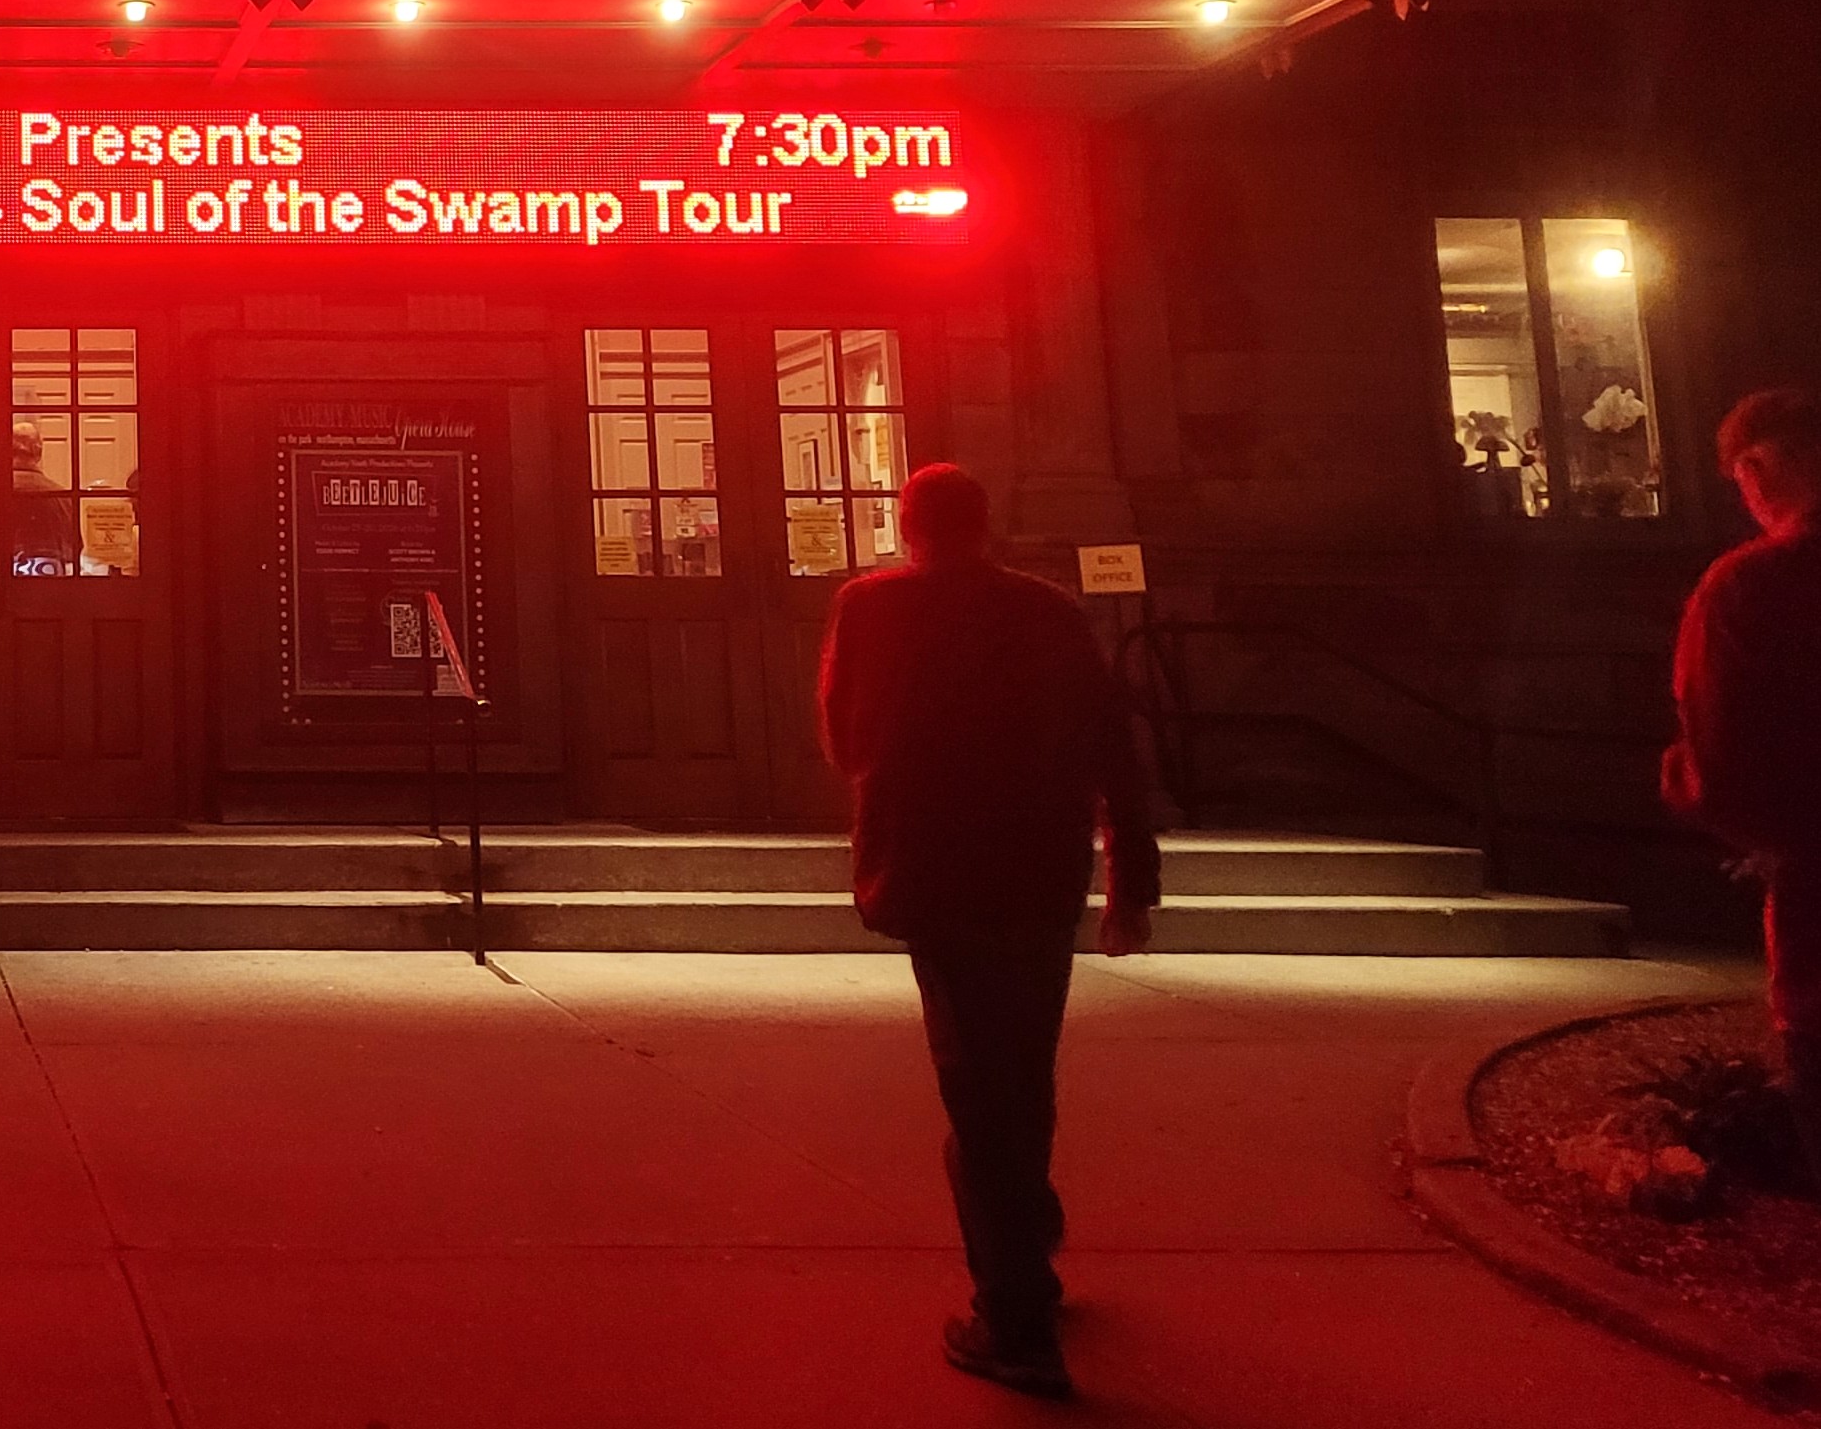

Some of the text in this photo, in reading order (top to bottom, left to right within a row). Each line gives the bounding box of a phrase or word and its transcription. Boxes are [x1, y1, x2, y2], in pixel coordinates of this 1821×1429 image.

[22, 114, 302, 164] Presents
[709, 114, 950, 177] 7:30pm
[23, 180, 164, 231] Soul
[187, 180, 251, 231] of
[264, 180, 362, 232] the
[386, 180, 622, 244] Swamp
[640, 180, 790, 233] Tour
[1093, 572, 1134, 583] OFFICE
[1097, 555, 1123, 565] BOX
